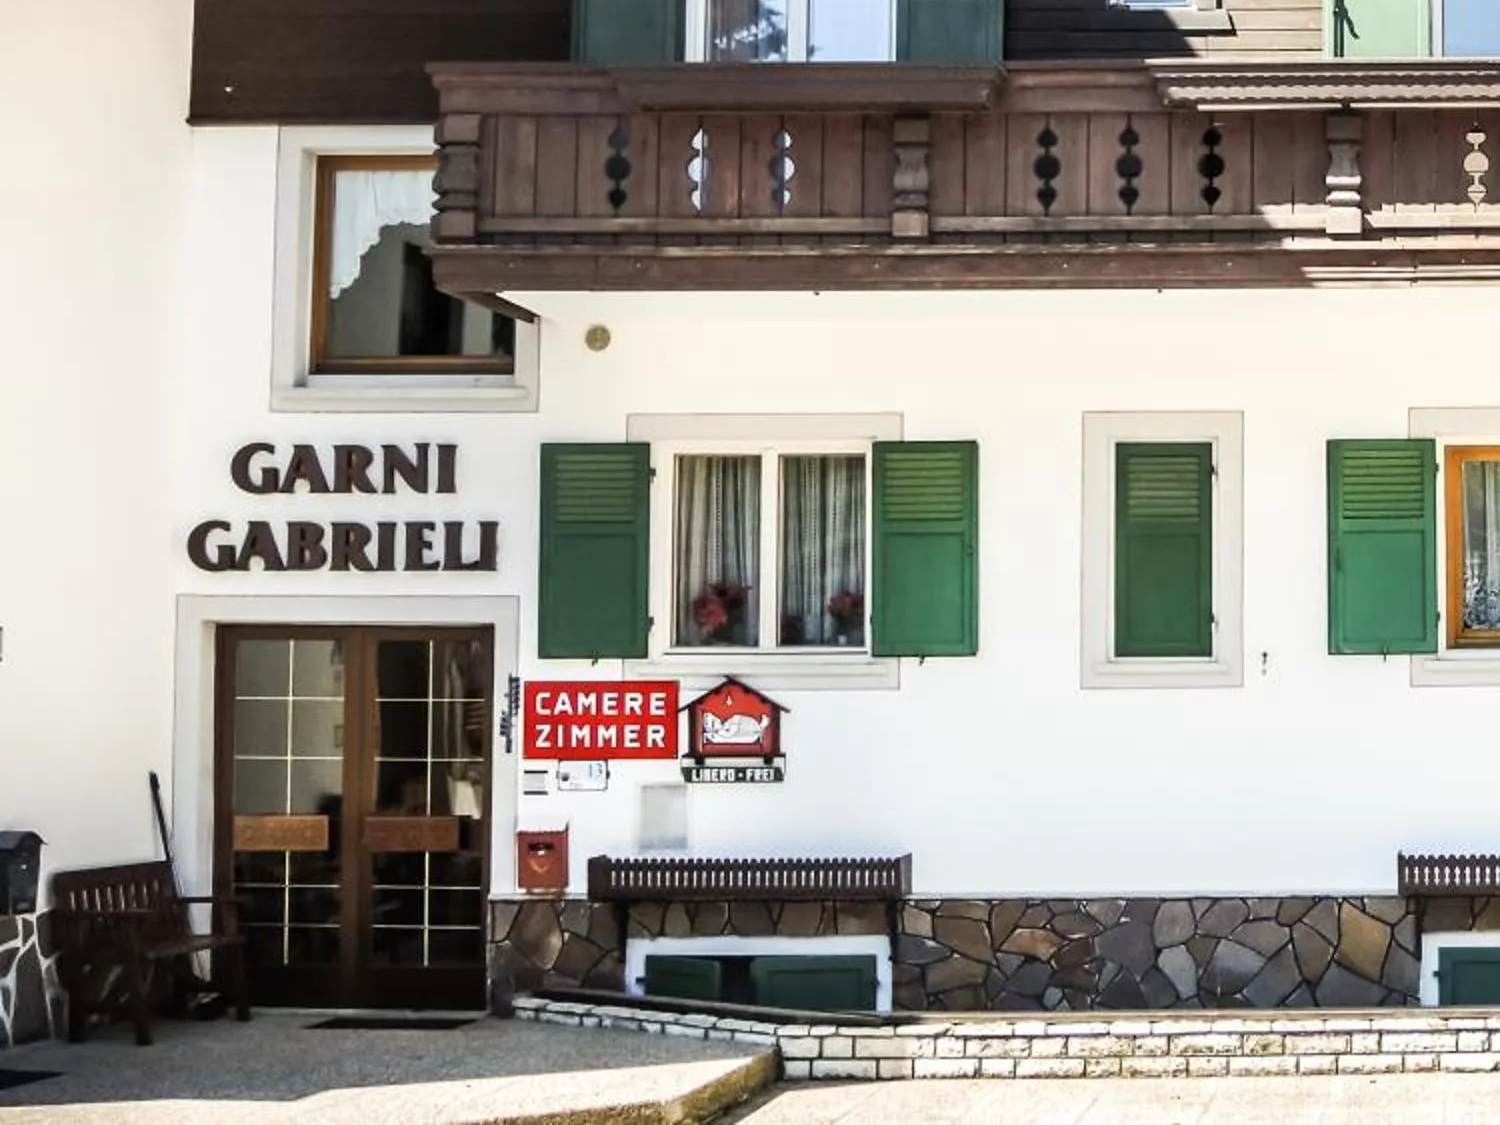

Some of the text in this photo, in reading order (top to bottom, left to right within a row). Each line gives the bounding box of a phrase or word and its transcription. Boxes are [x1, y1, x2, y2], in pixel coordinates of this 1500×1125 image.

[230, 442, 458, 495] GARNI
[187, 520, 500, 572] GABRIELI
[535, 691, 667, 716] CAMERE
[535, 724, 666, 748] ZIMMER
